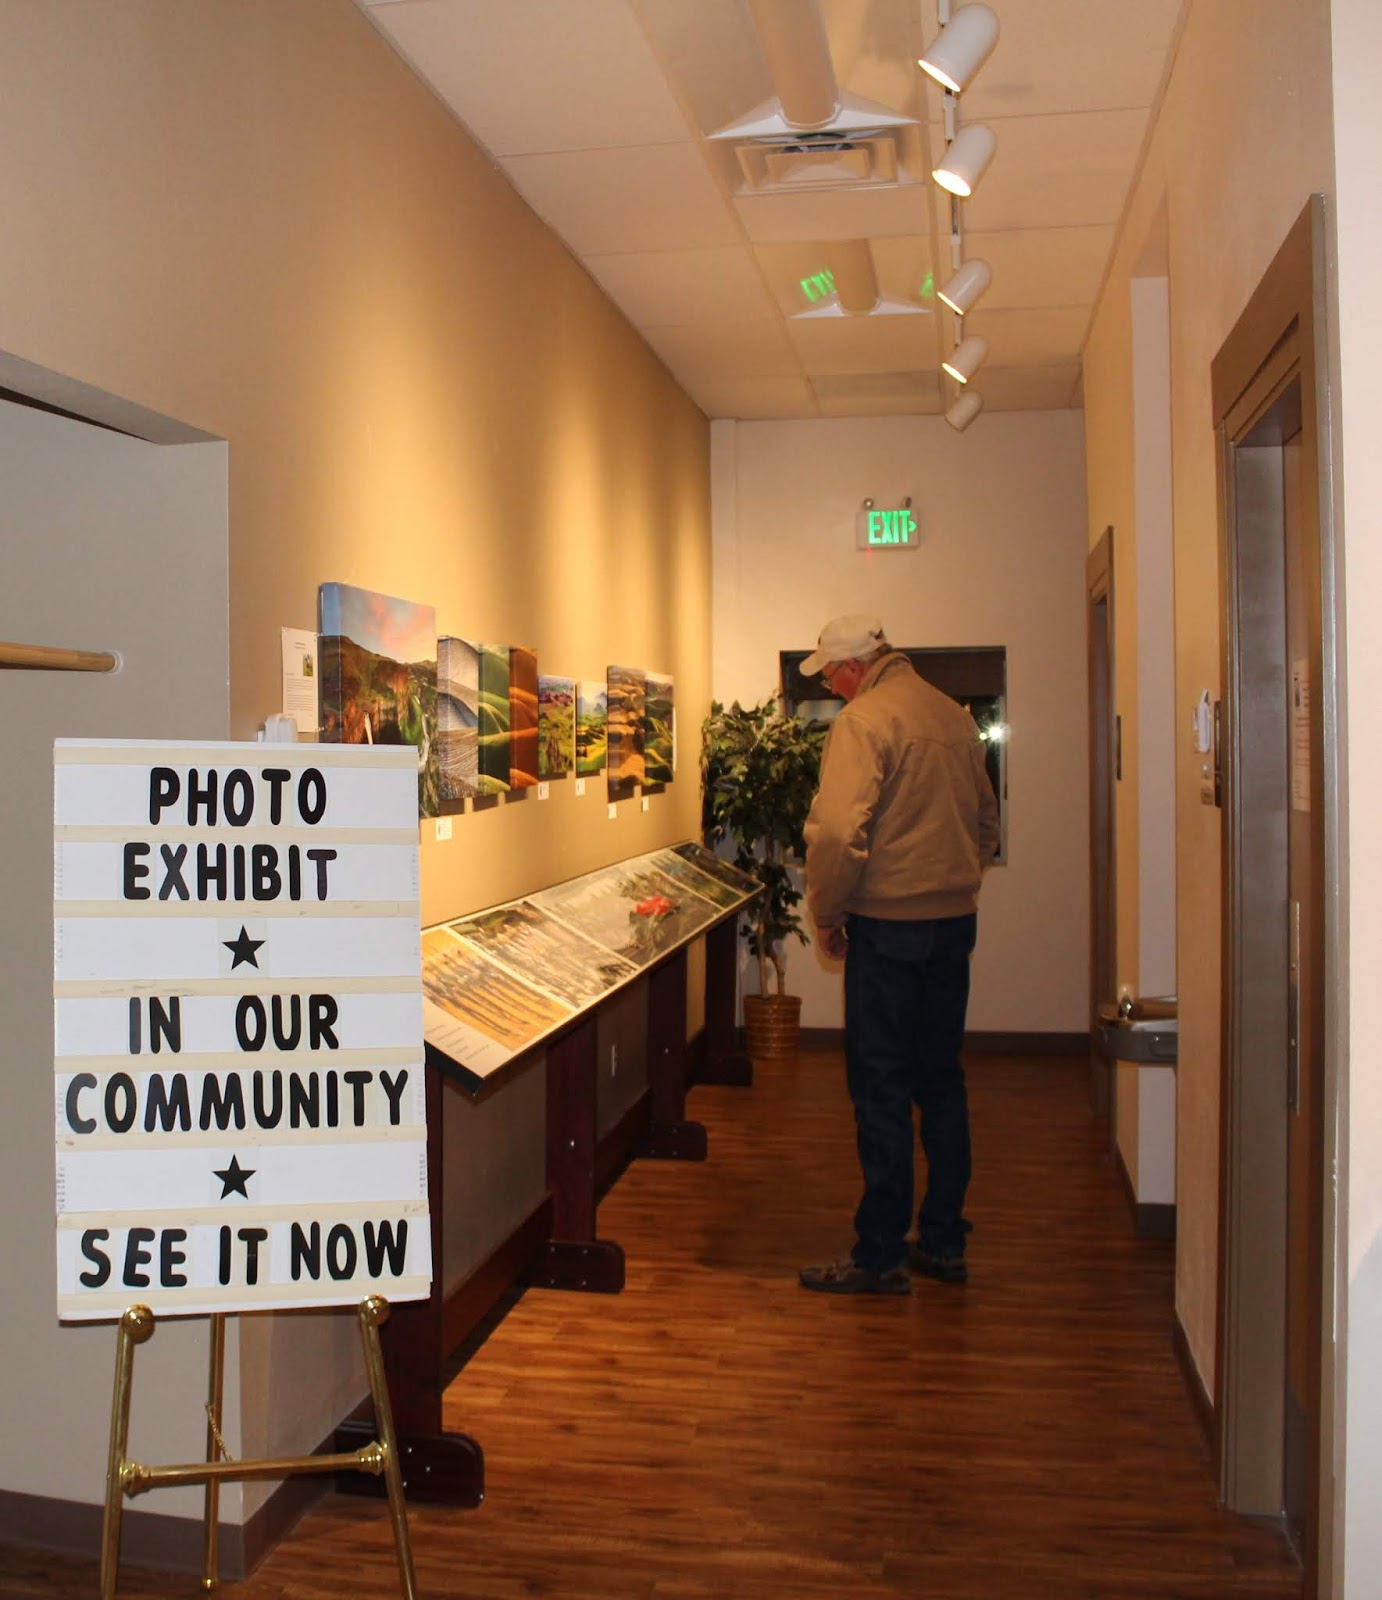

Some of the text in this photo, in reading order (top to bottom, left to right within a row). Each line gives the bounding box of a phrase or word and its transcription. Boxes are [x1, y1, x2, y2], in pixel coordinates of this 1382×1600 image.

[869, 509, 910, 544] EXIT
[149, 767, 327, 826] PHOTO
[123, 843, 337, 901] EXHIBIT
[129, 994, 339, 1054] IN OUR
[65, 1070, 409, 1133] COMMUNITY
[79, 1219, 408, 1288] SEE IT NOW
